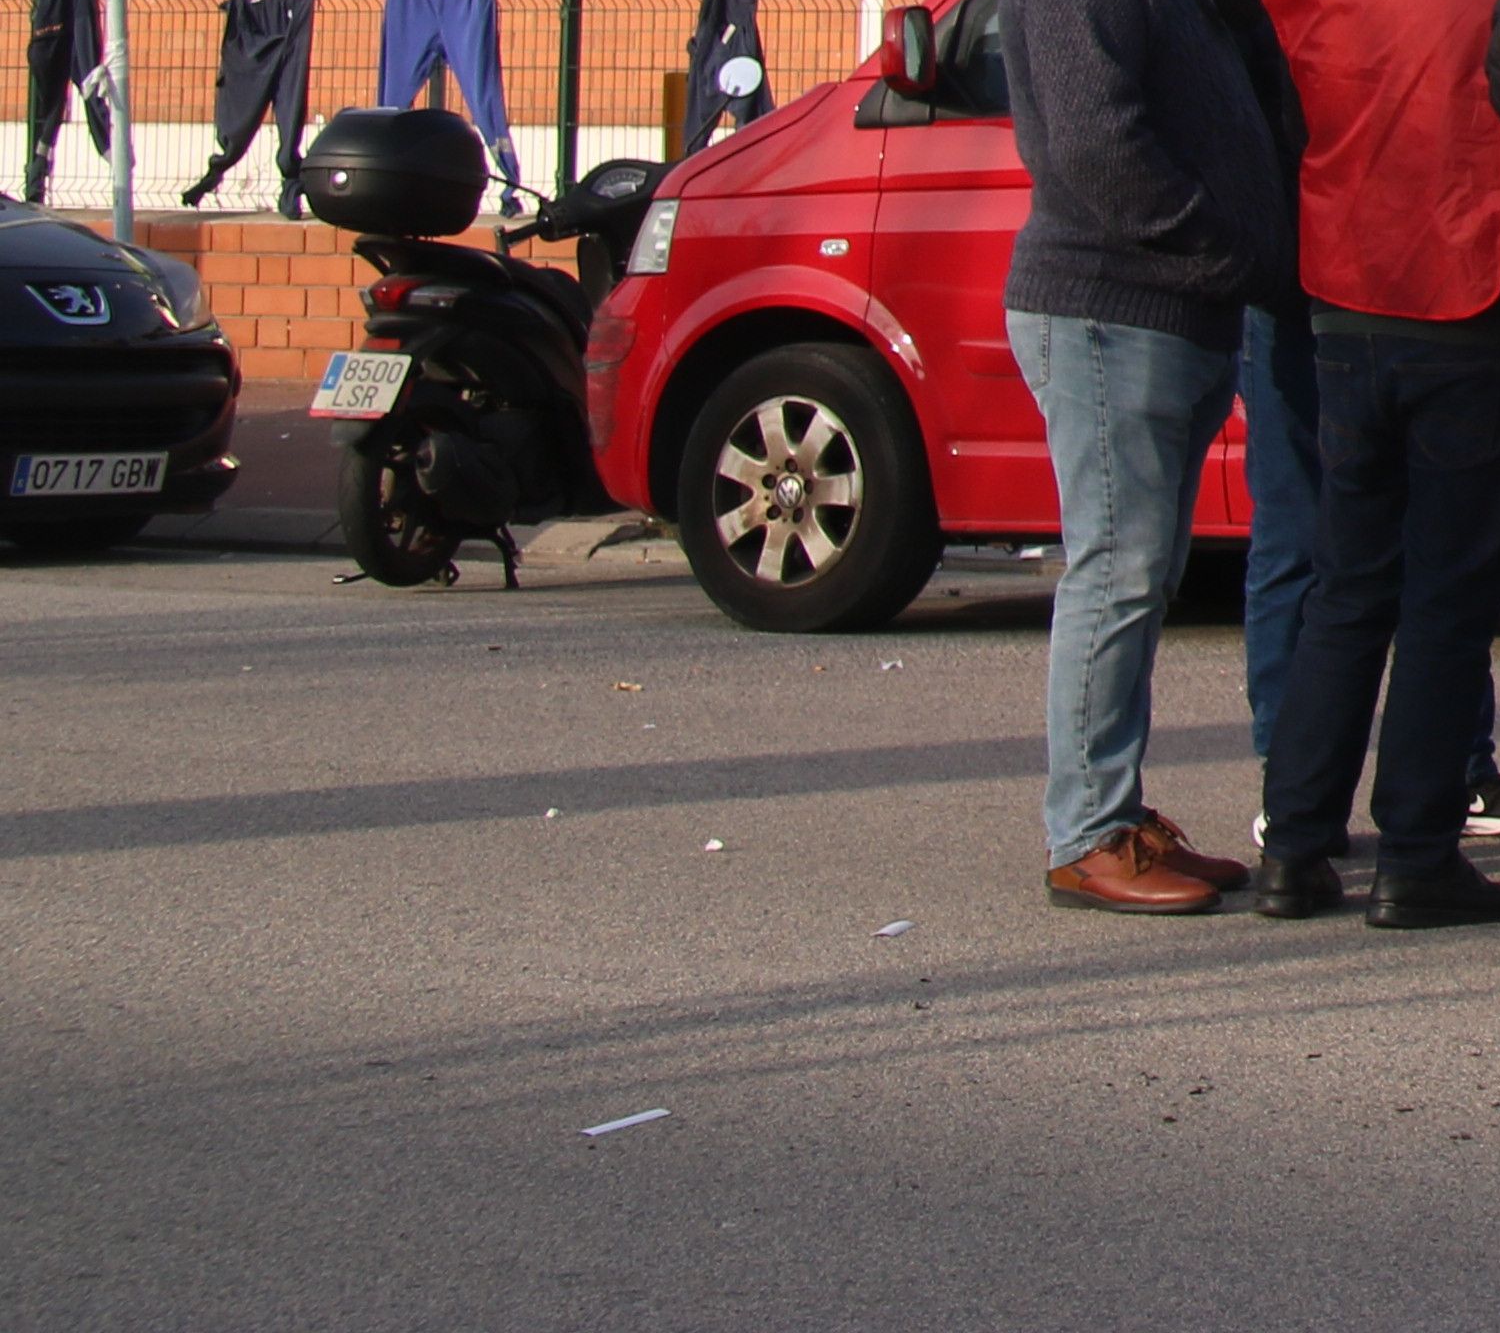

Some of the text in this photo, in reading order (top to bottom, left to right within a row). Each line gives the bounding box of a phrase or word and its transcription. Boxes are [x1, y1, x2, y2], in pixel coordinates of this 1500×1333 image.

[344, 359, 403, 384] 8500
[332, 384, 379, 408] LSR
[32, 458, 161, 490] 0717 GBW
